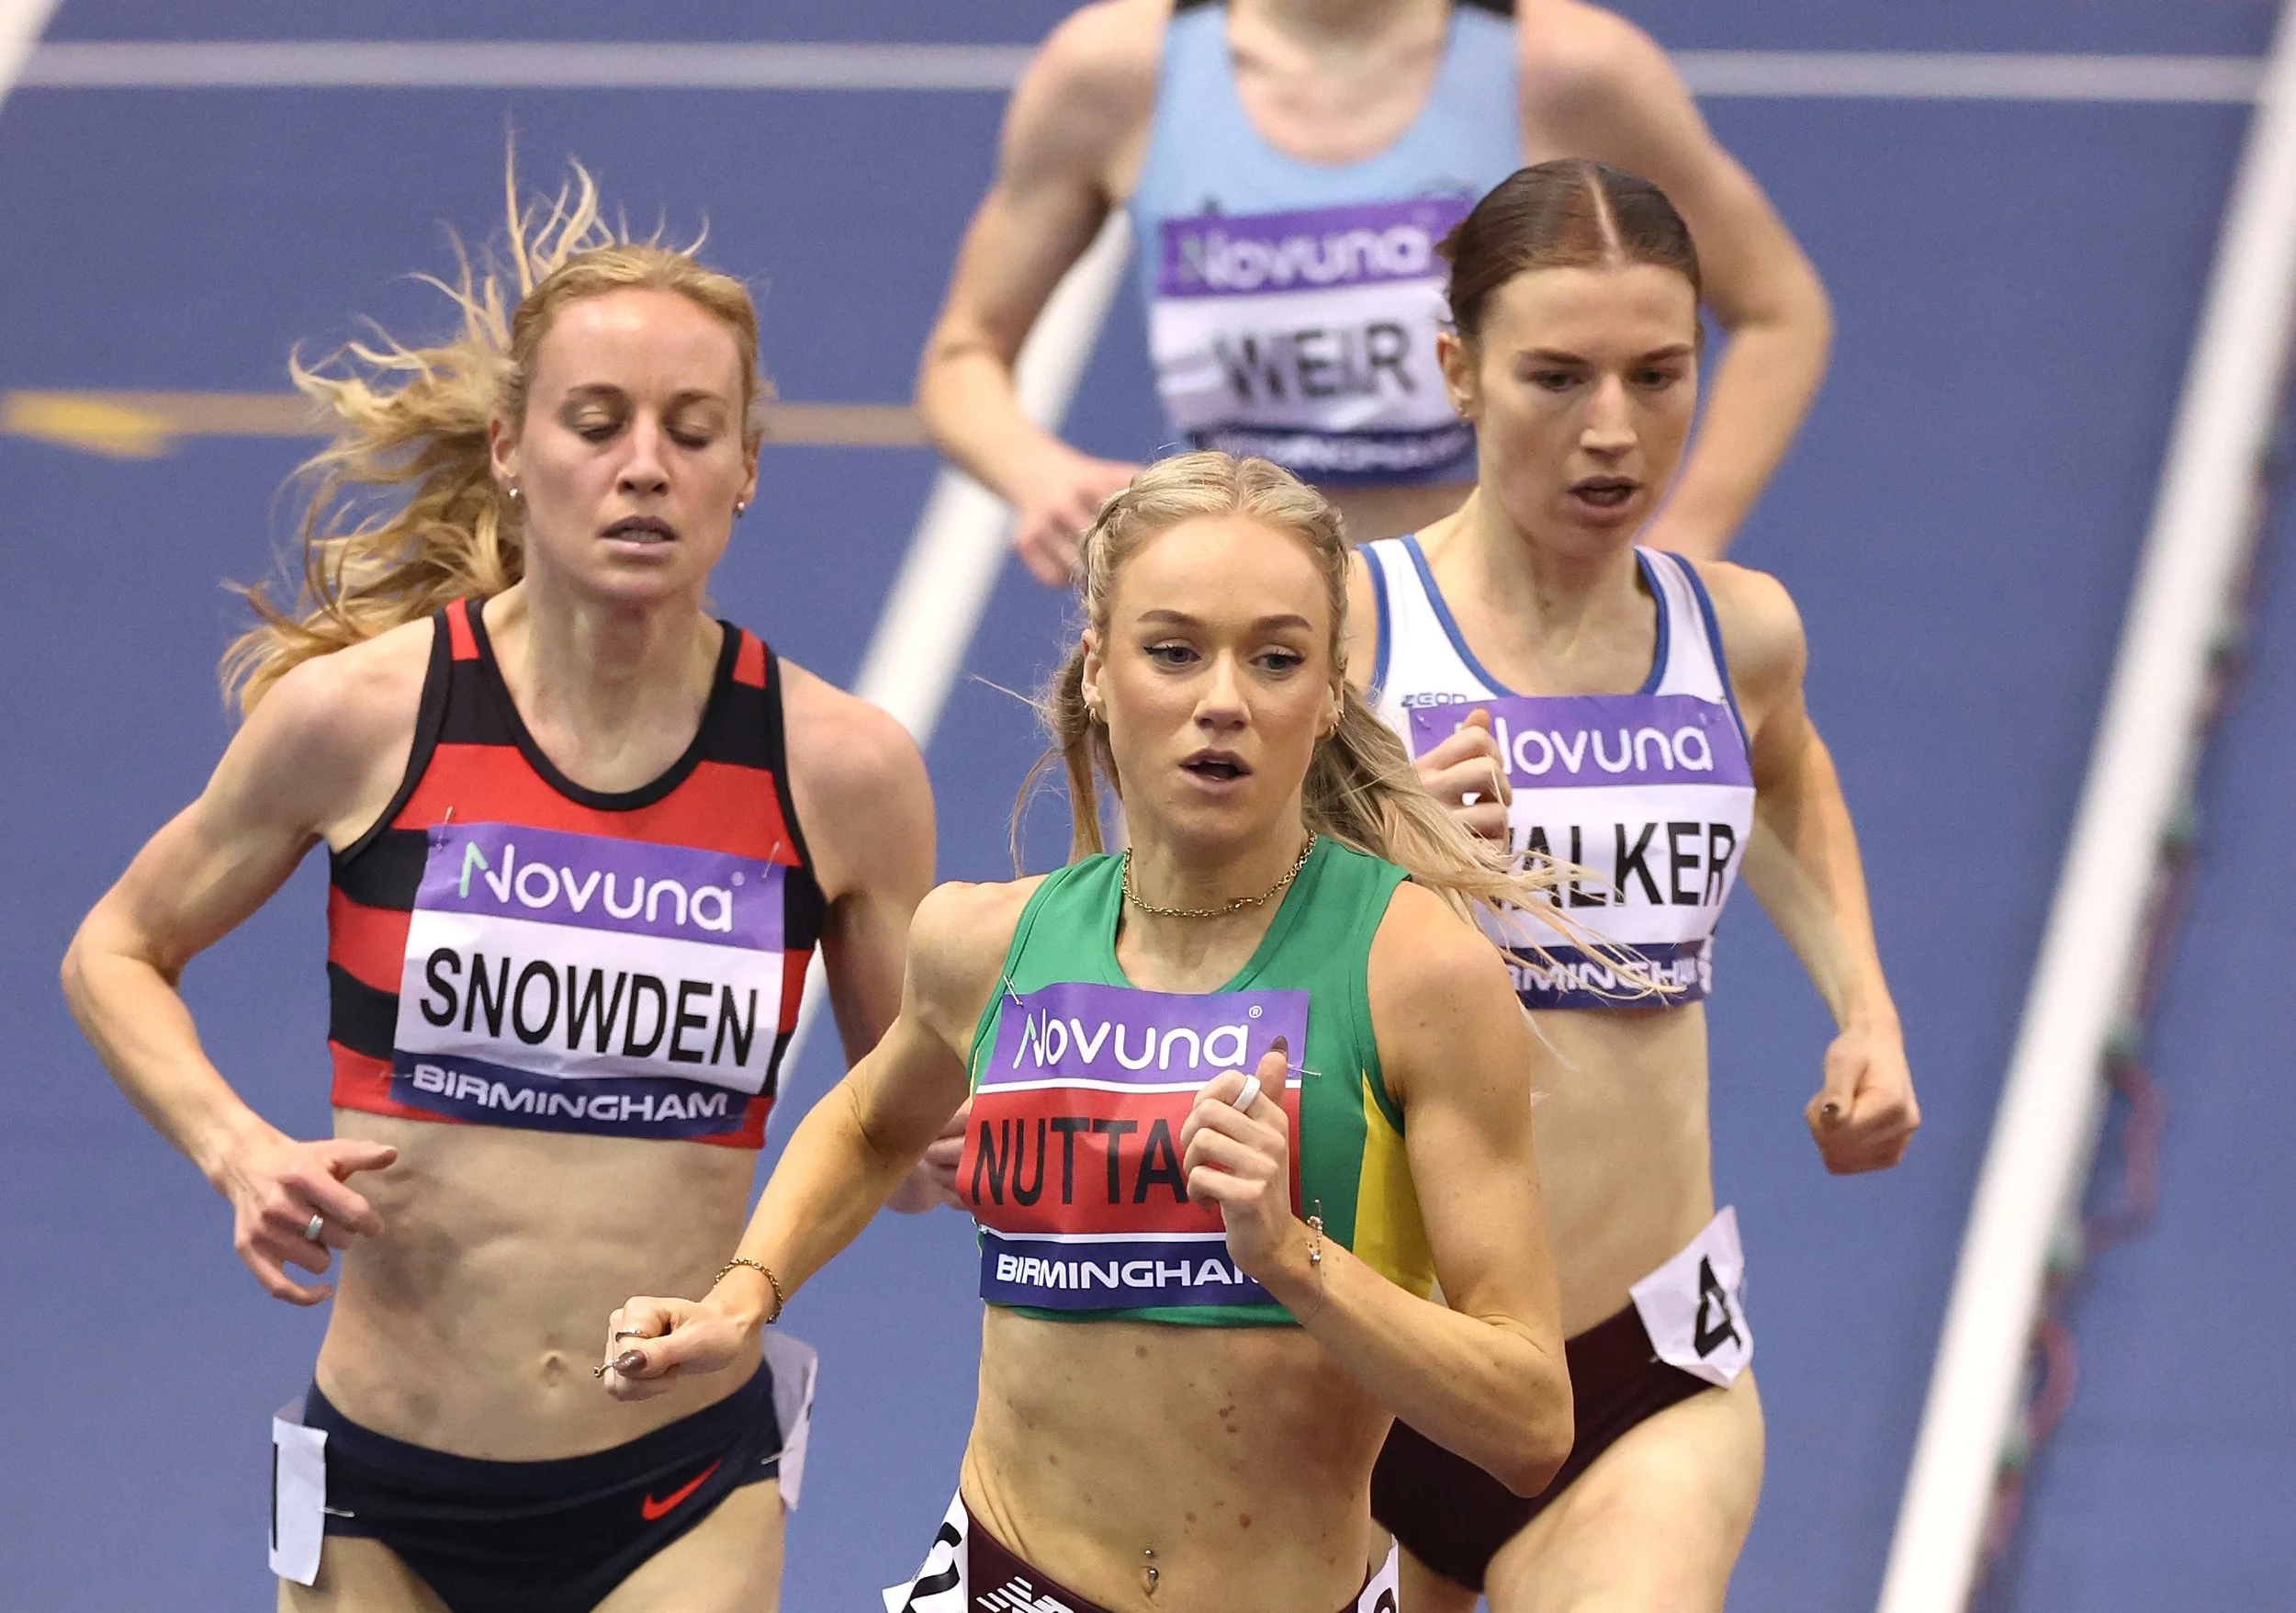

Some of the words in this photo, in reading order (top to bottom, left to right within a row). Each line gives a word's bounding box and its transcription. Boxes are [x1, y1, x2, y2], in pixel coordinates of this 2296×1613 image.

[459, 840, 733, 932] Novuna
[1489, 822, 1737, 910] ALKER
[420, 947, 759, 1067] SNOWDEN
[1012, 1007, 1249, 1070] Novuna
[412, 1064, 729, 1122] BIRMINGHAM
[972, 1116, 1188, 1207] NUTTA
[1694, 1253, 1741, 1359] 4
